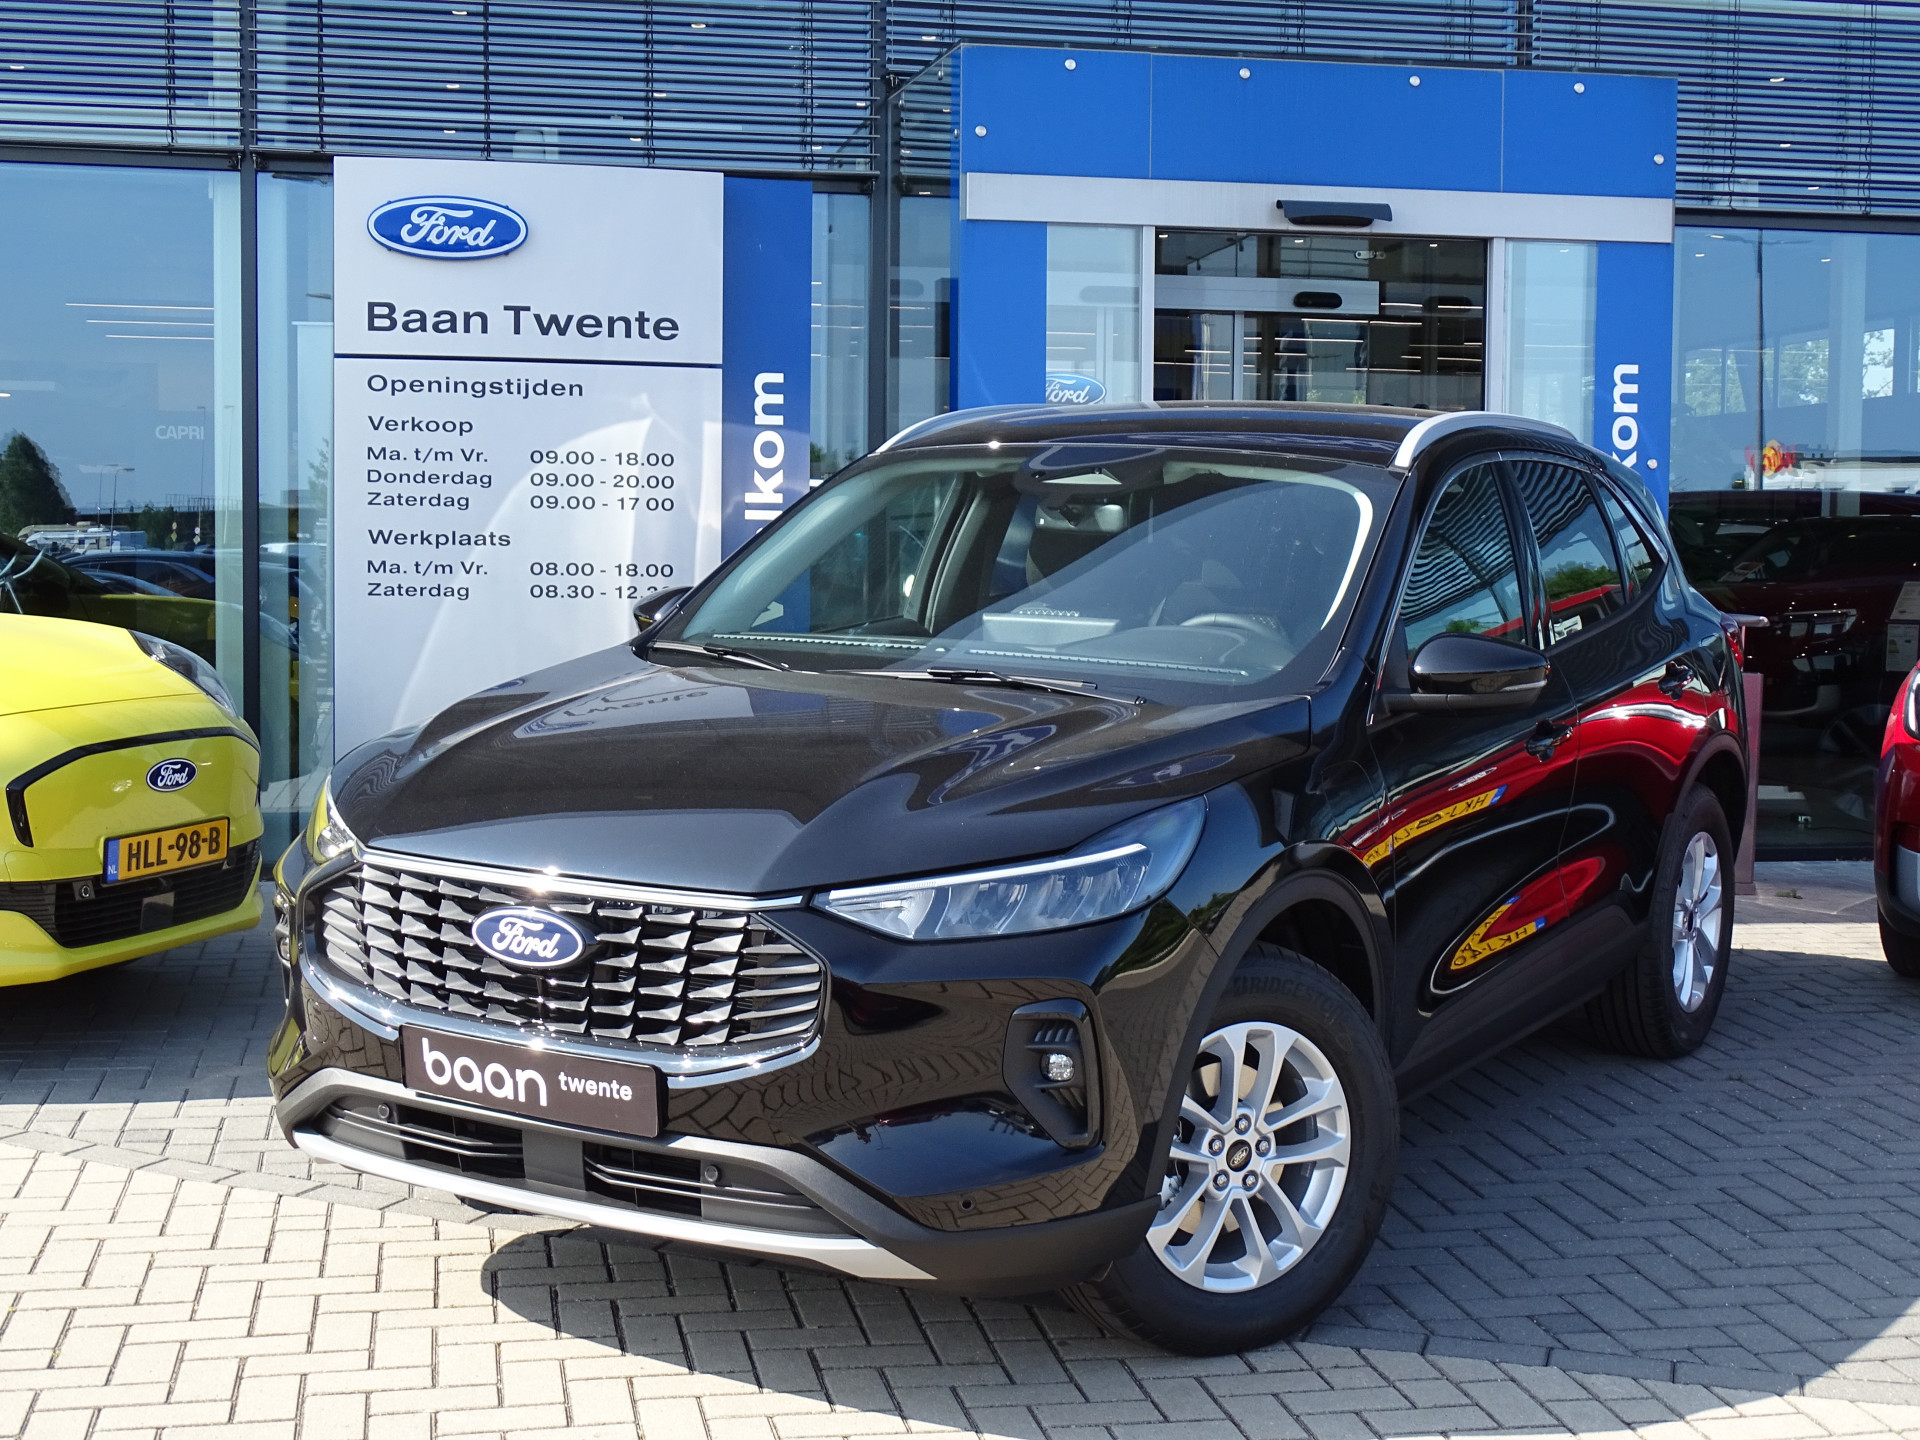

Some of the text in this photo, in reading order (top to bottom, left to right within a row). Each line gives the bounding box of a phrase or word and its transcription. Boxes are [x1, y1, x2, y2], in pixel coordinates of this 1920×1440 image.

[401, 205, 497, 247] Ford
[366, 301, 680, 341] Baan Twente
[366, 374, 584, 399] Openingstijden
[155, 425, 205, 440] CAPRI
[367, 415, 474, 437] Verkoop
[367, 446, 407, 461] Ma.
[413, 447, 453, 463] t/m
[460, 448, 488, 462] Vr.
[530, 450, 594, 465] 09.00
[614, 452, 675, 467] 18.00
[744, 372, 785, 534] lkom
[367, 469, 492, 488] Donderdag
[530, 472, 594, 487] 09.00
[613, 474, 675, 489] 20.00
[367, 491, 470, 511] Zaterdag
[530, 495, 596, 510] 09.00
[367, 529, 511, 549] Werkplaats
[367, 560, 407, 574] Ma.
[413, 561, 453, 576] t/m
[460, 561, 488, 575] Vr.
[530, 562, 594, 577] 08.00
[614, 563, 674, 578] 18.00
[367, 582, 470, 601] Zaterdag
[530, 584, 594, 599] 08.30
[614, 585, 670, 599] 12.
[157, 763, 188, 787] Ford
[126, 826, 222, 873] HLL-98-B
[107, 865, 118, 875] NL
[491, 916, 561, 959] Ford
[1233, 974, 1346, 1019] BRIDGESTON
[421, 1036, 633, 1107] baan twente
